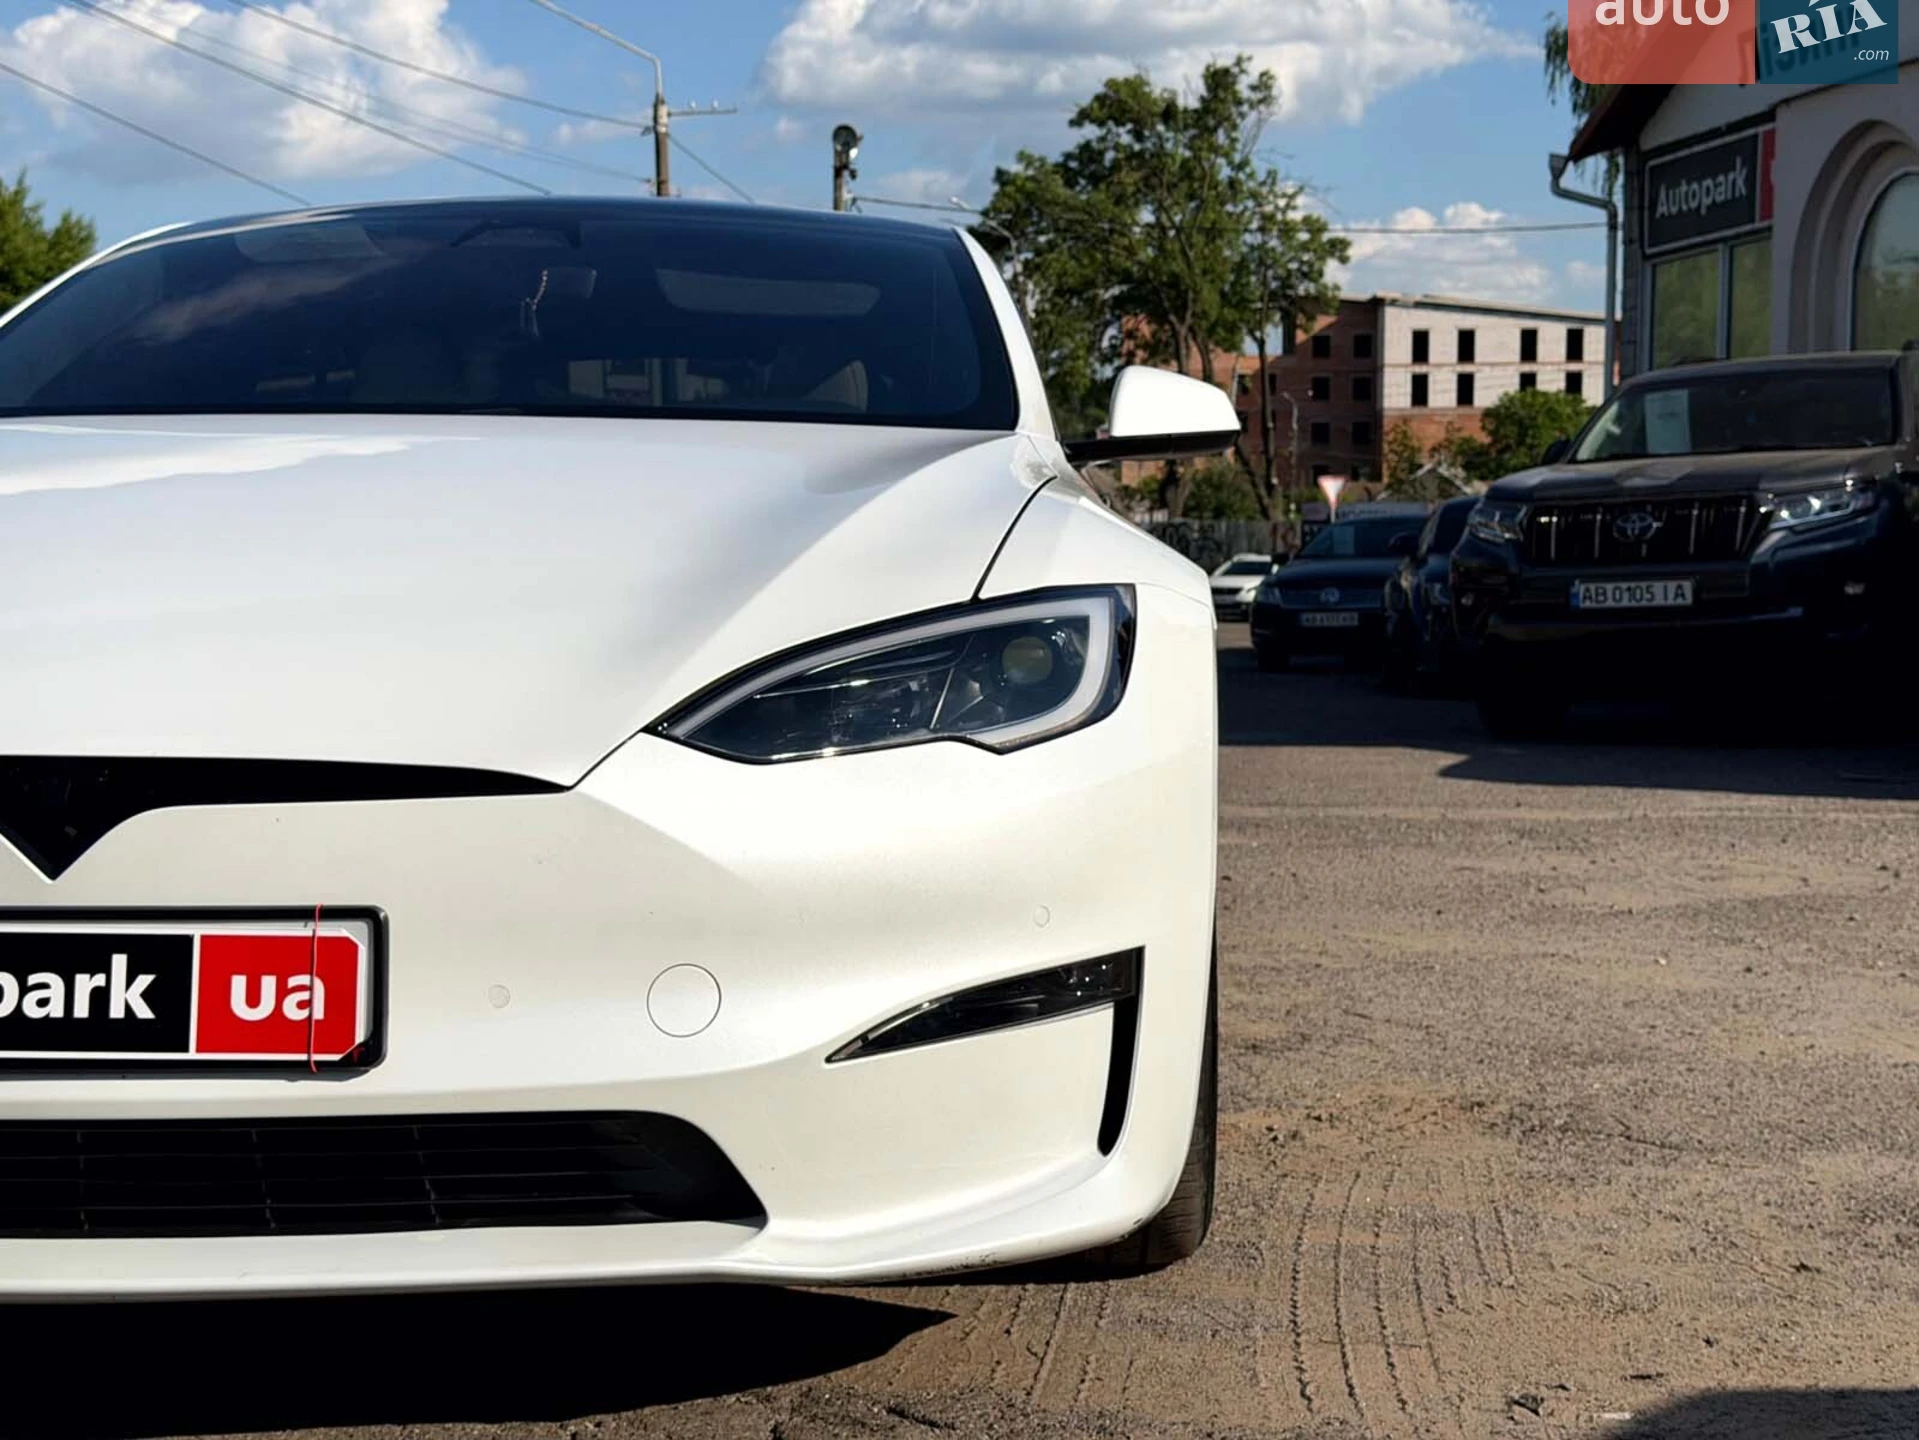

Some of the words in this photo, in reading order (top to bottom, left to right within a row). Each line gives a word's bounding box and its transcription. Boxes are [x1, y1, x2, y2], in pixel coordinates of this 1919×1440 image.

[1655, 156, 1747, 219] Autopark
[1582, 586, 1607, 604] AB
[1612, 584, 1655, 603] 0105
[229, 974, 326, 1021] ua
